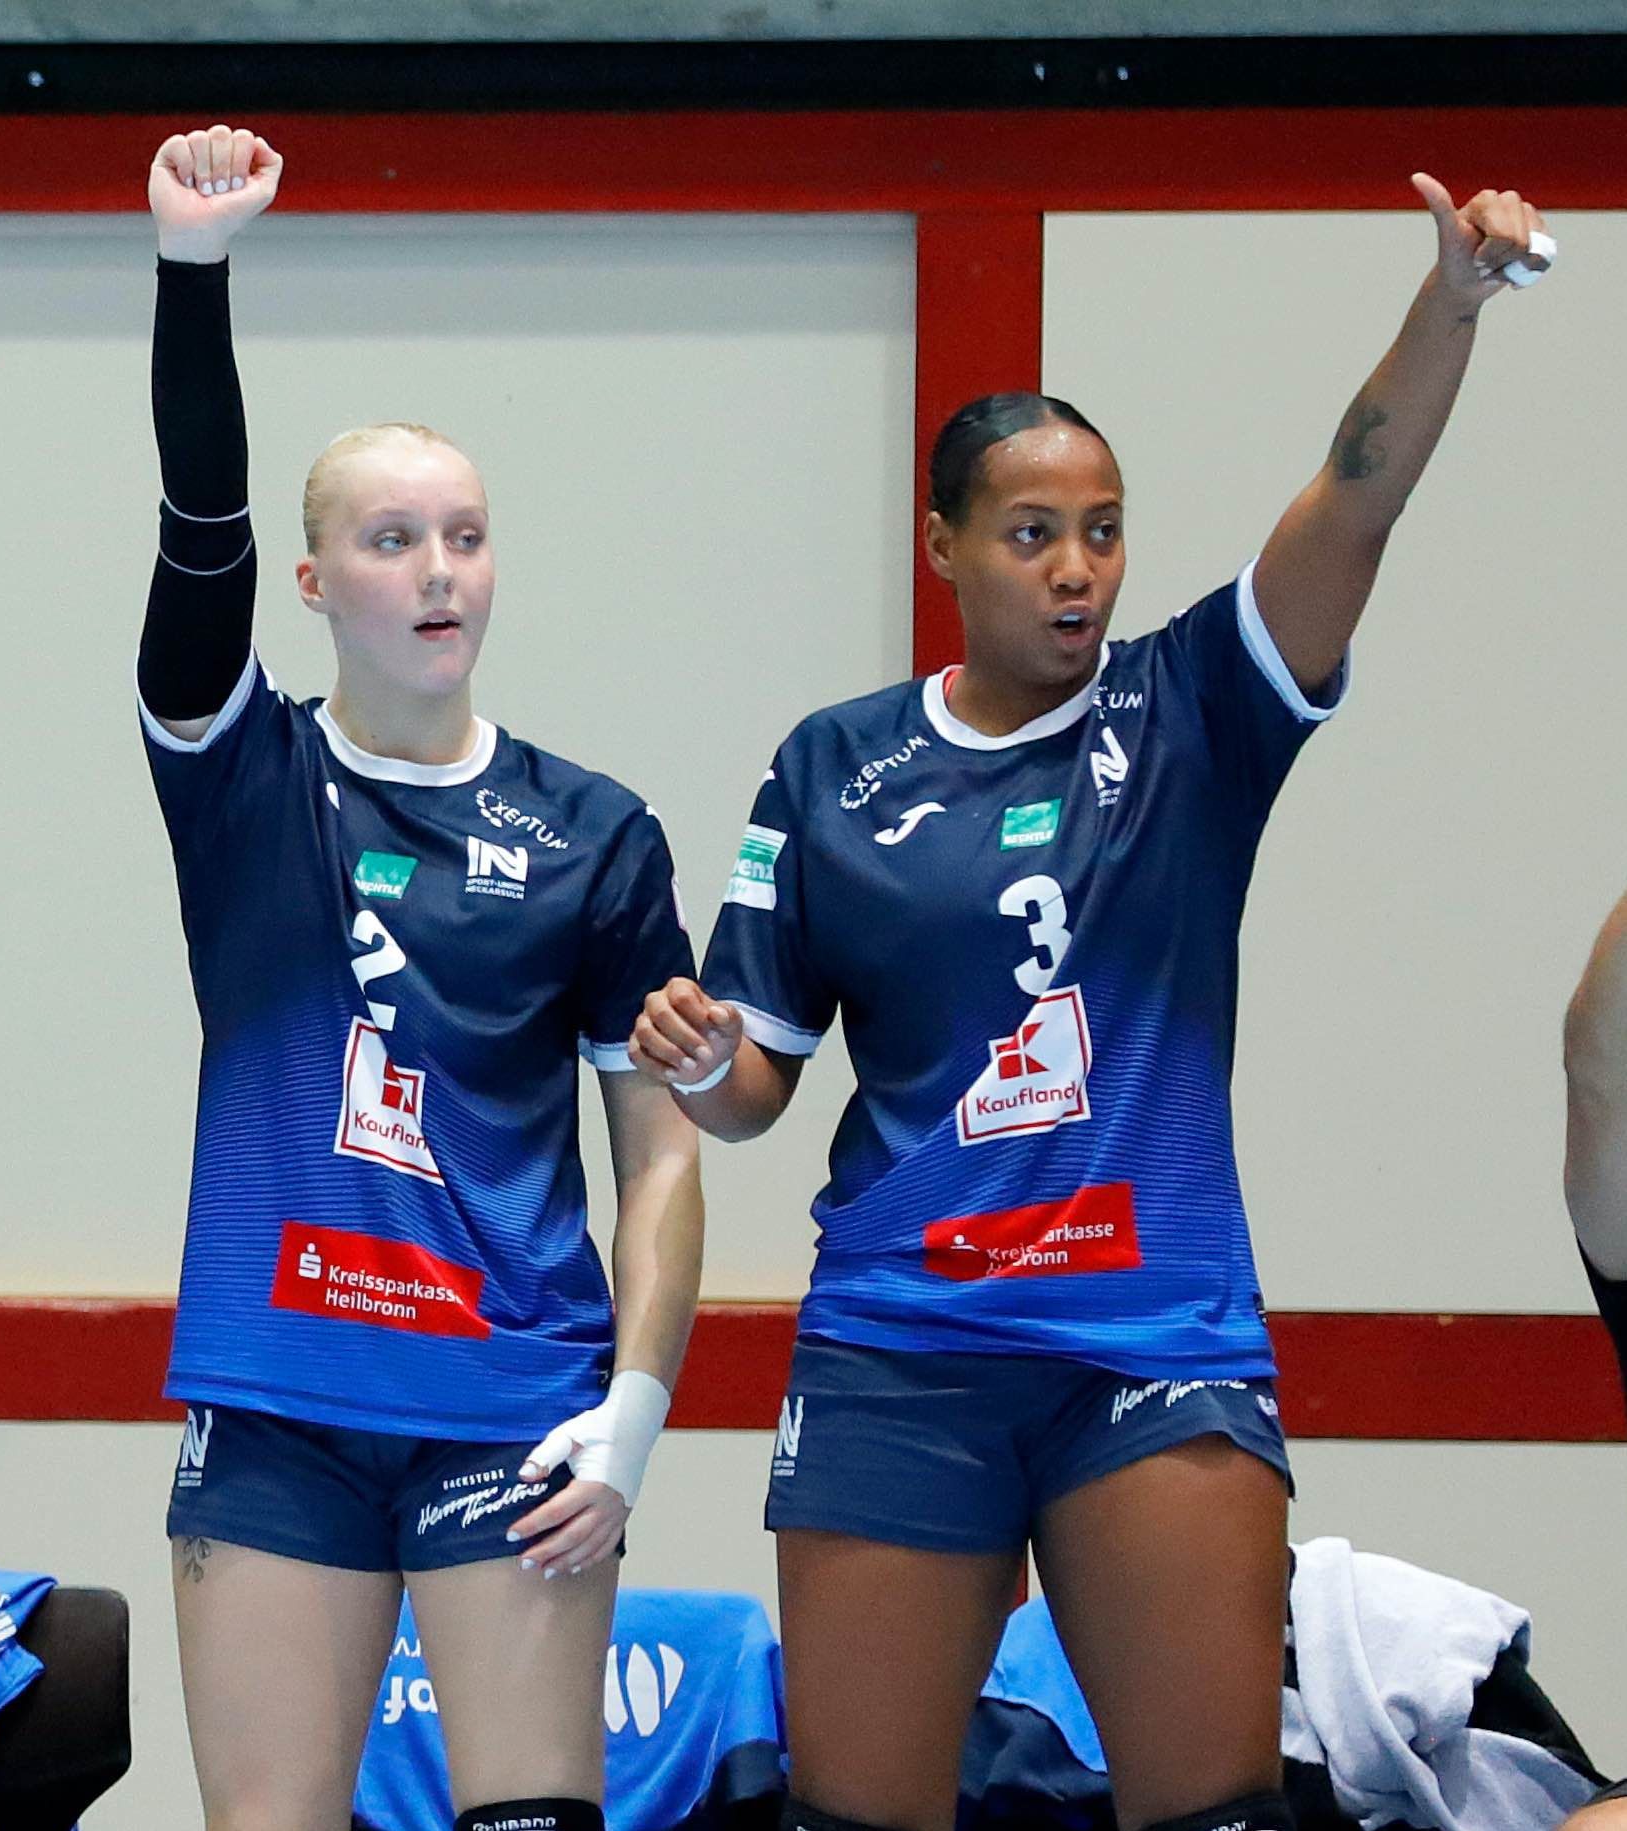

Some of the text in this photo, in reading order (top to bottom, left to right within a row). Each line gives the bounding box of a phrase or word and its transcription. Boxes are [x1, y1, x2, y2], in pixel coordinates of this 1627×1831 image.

[998, 874, 1072, 996] 3
[351, 909, 406, 1031] 2
[976, 1081, 1076, 1116] Kaufland
[354, 1110, 429, 1150] Kauflan
[325, 1287, 417, 1320] Heilbronn
